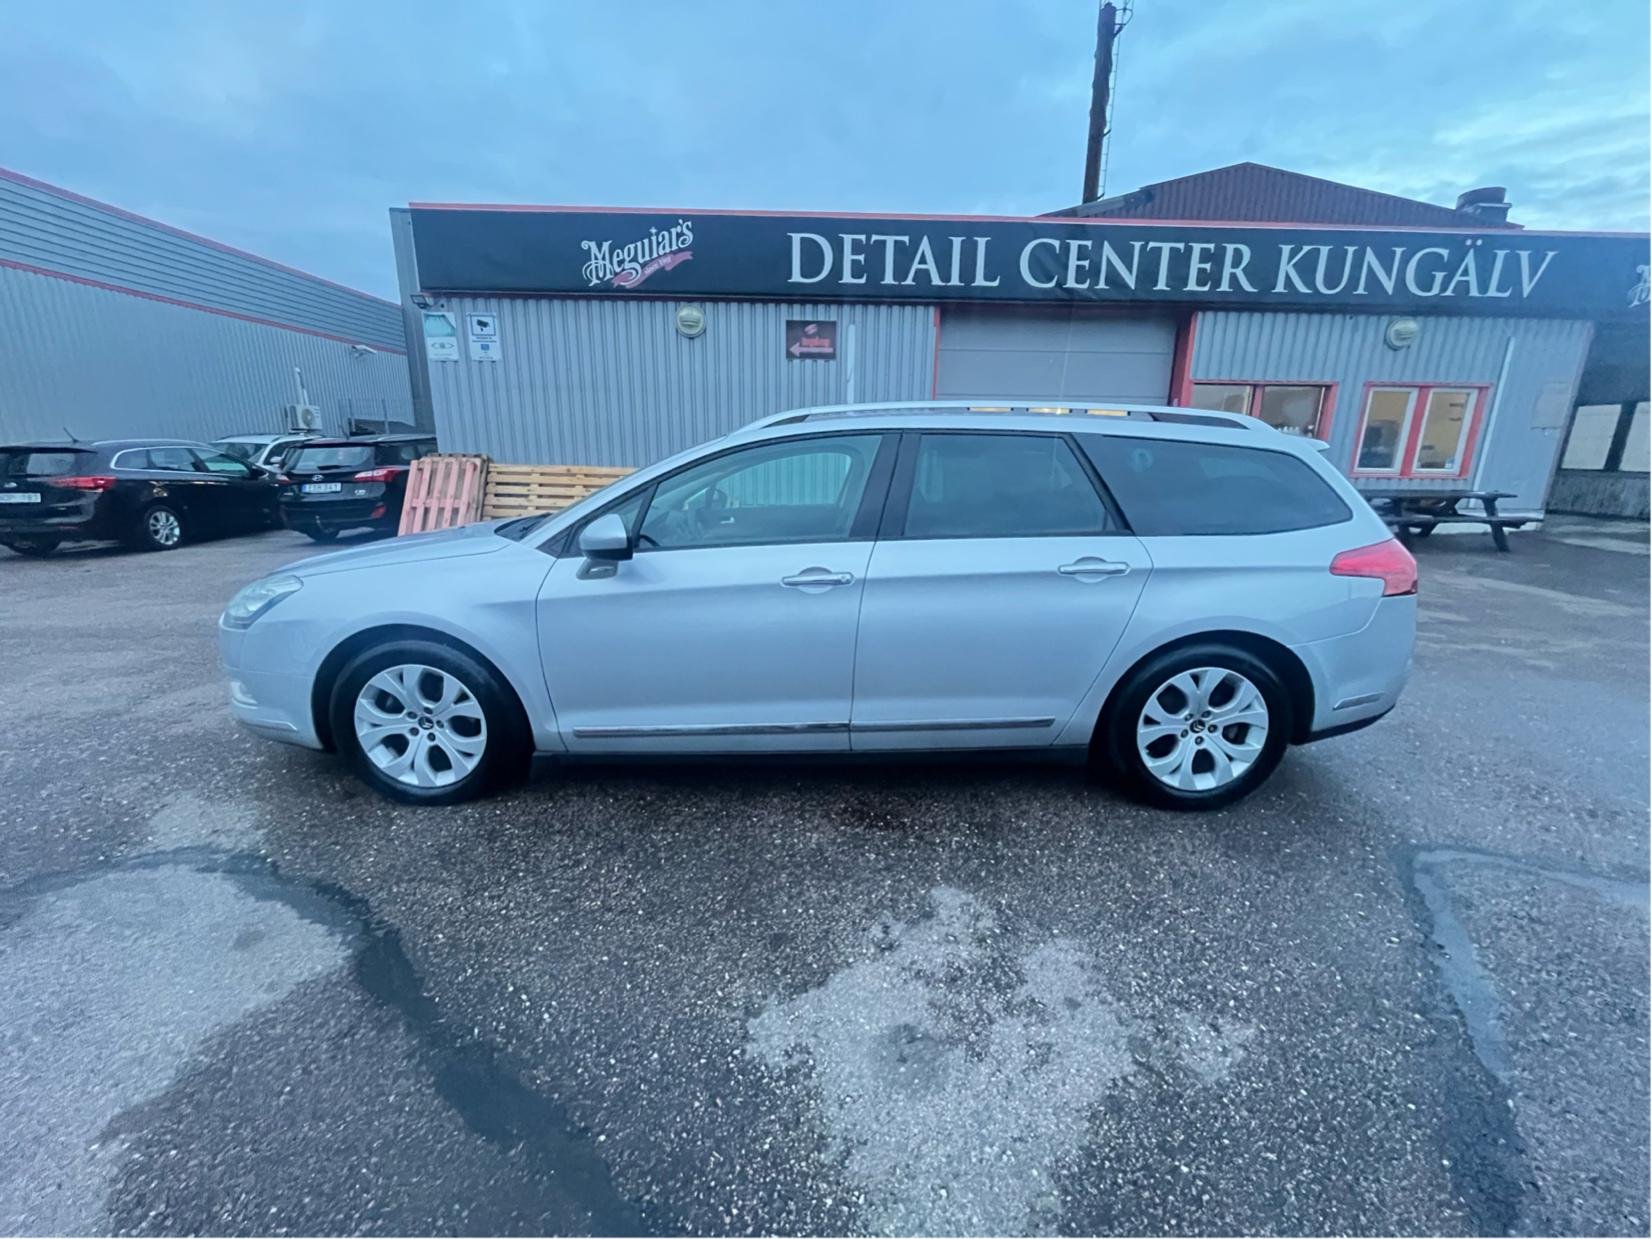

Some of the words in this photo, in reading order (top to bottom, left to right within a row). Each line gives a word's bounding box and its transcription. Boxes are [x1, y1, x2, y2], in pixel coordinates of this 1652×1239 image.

[581, 219, 694, 287] Meguiar's
[786, 232, 1001, 287] DETAIL
[1019, 237, 1258, 293] CENTER
[1271, 238, 1559, 298] KUNGÄLV
